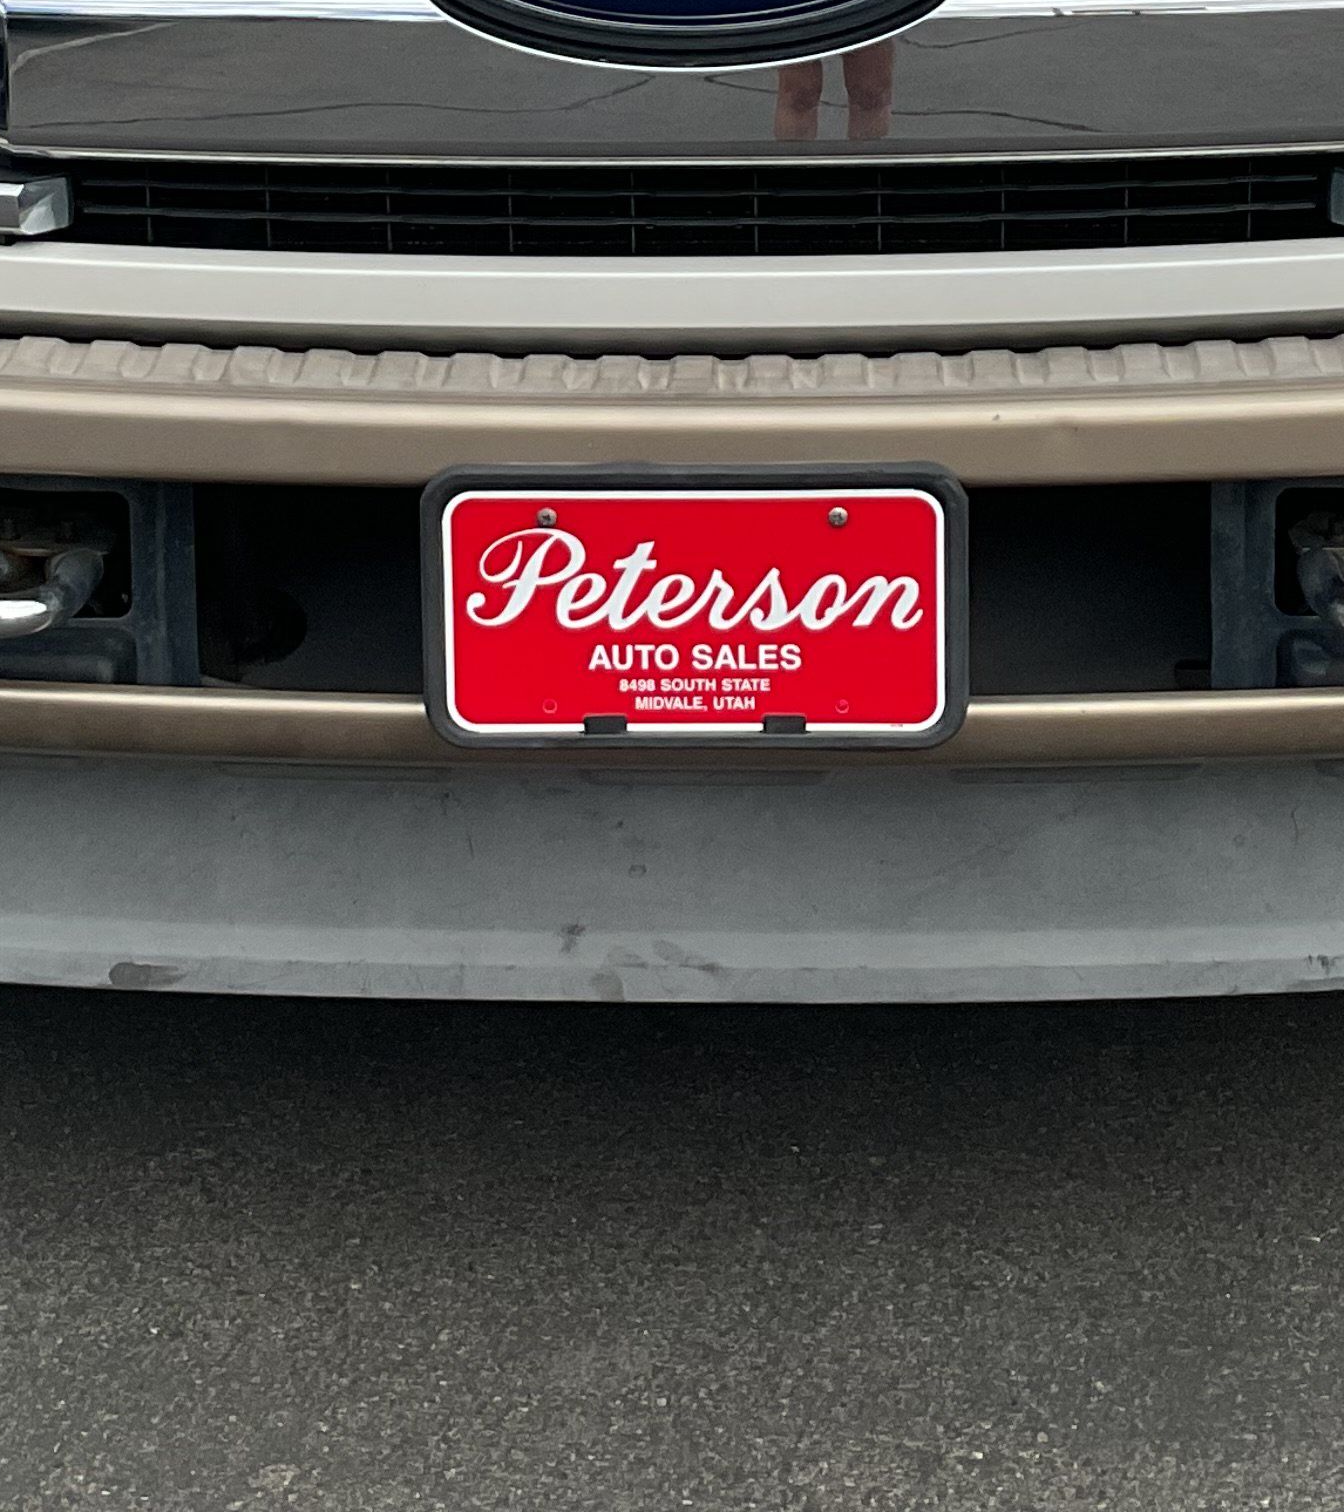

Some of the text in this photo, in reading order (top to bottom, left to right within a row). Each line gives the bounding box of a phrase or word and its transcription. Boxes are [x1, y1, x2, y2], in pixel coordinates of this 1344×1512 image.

[466, 528, 924, 632] Peterson
[588, 644, 802, 671] AUTO SALES
[619, 678, 771, 692] 8498 SOUTH STATE
[634, 696, 756, 711] MIDVALE, UTAH
